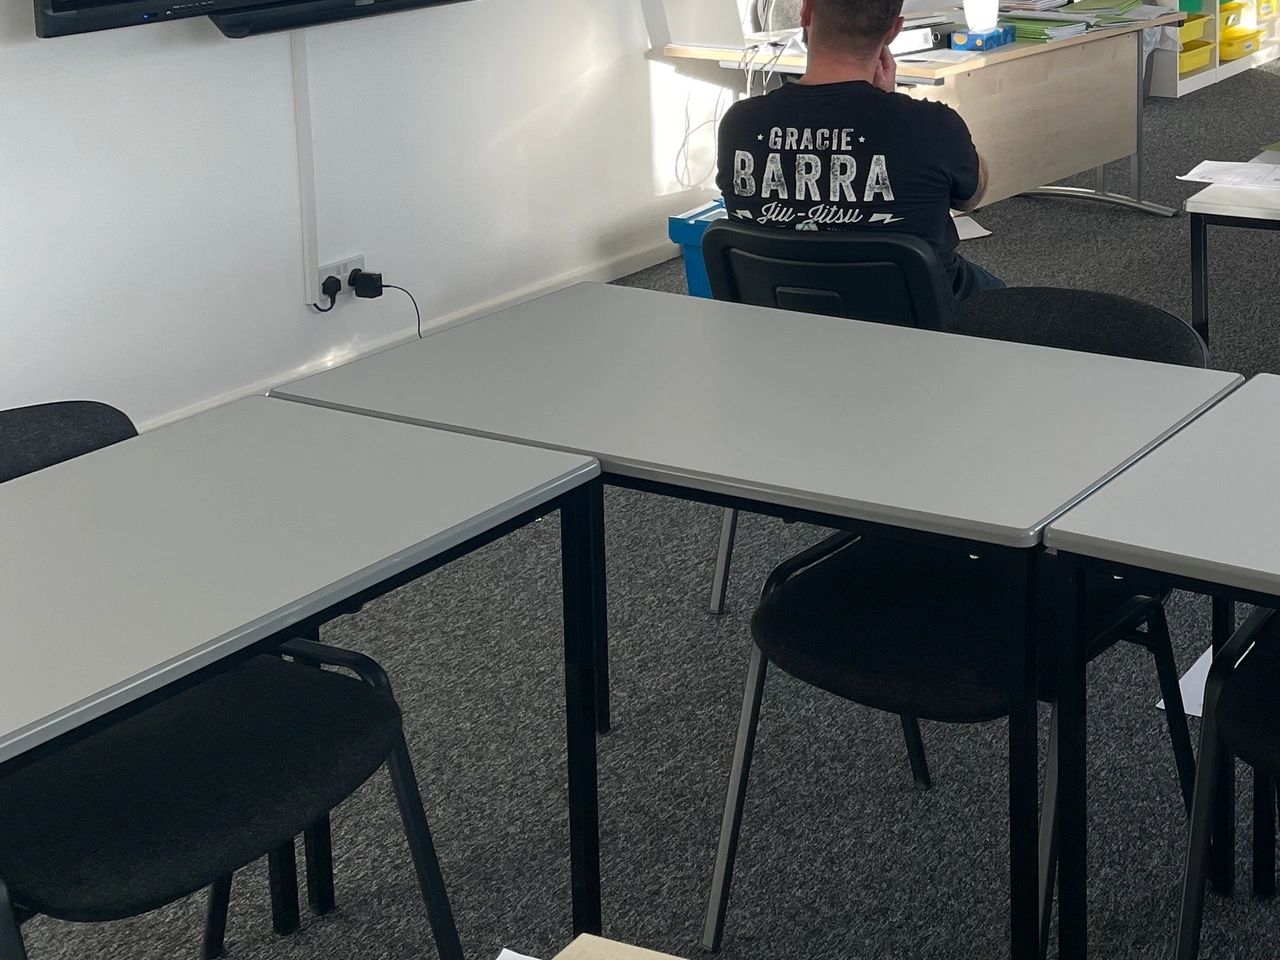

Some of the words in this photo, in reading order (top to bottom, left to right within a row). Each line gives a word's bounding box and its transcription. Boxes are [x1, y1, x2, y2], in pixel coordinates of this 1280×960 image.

[768, 126, 855, 151] GRACIE
[732, 149, 896, 203] BARRA
[756, 201, 864, 225] Jiu-Jitsu
